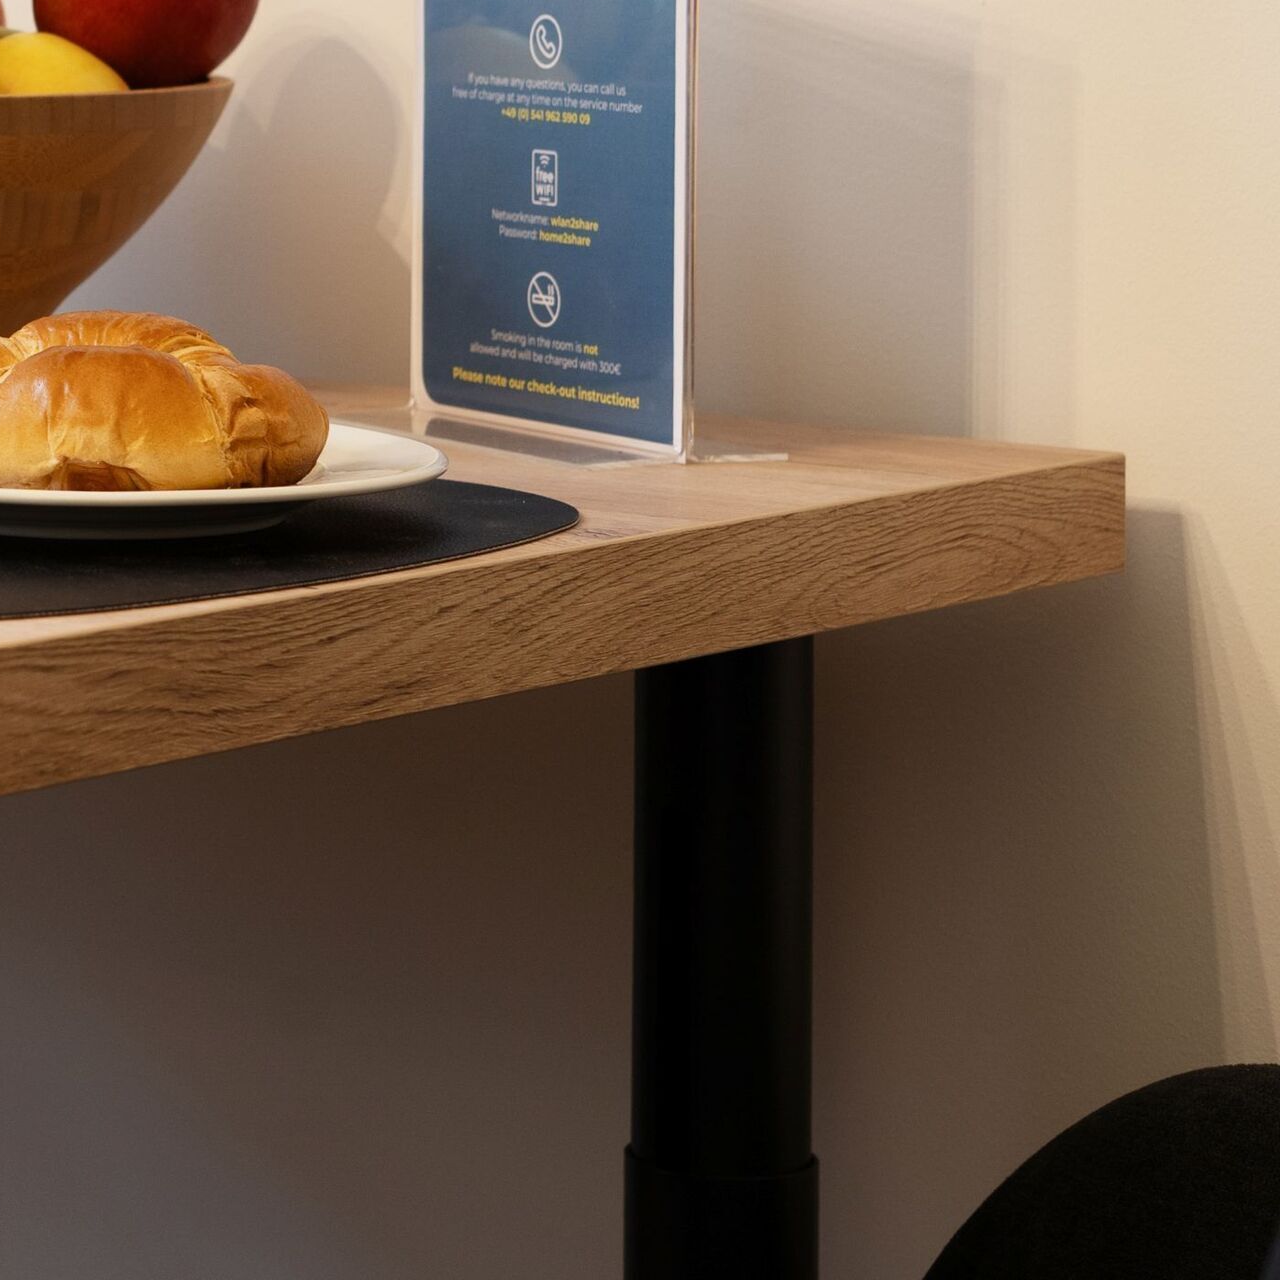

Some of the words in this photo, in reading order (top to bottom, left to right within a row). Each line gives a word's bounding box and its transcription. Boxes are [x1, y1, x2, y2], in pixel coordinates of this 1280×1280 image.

[474, 75, 489, 86] you
[490, 74, 509, 87] have
[510, 78, 525, 90] any
[526, 79, 566, 93] questions,
[566, 82, 582, 94] you
[584, 83, 599, 94] can
[601, 82, 615, 95] call
[616, 86, 626, 96] us
[452, 85, 468, 99] free
[469, 88, 478, 99] of
[478, 89, 505, 104] charge
[507, 92, 515, 103] at
[517, 94, 530, 107] any
[531, 94, 551, 106] time
[552, 97, 563, 107] on
[564, 97, 578, 109] the
[580, 99, 608, 111] service
[609, 101, 643, 114] number
[501, 107, 517, 119] +49
[518, 107, 529, 122] (0)
[530, 109, 544, 121] 541
[579, 113, 591, 126] 09
[536, 166, 554, 183] free
[551, 216, 599, 231] wlan2share
[539, 229, 591, 246] home2share
[491, 328, 527, 347] Smoking
[528, 334, 536, 346] in
[537, 335, 551, 349] the
[552, 339, 574, 352] room
[575, 341, 582, 353] is
[583, 344, 599, 356] not
[470, 342, 500, 357] allowed
[501, 347, 517, 360] and
[518, 349, 531, 361] will
[532, 351, 543, 364] be
[544, 353, 578, 370] charged
[579, 358, 598, 371] with
[599, 361, 622, 376] 300€
[452, 366, 484, 384] Please
[485, 372, 508, 388] note
[508, 377, 526, 391] our
[527, 379, 576, 399] check-out
[578, 386, 640, 410] instructions!
